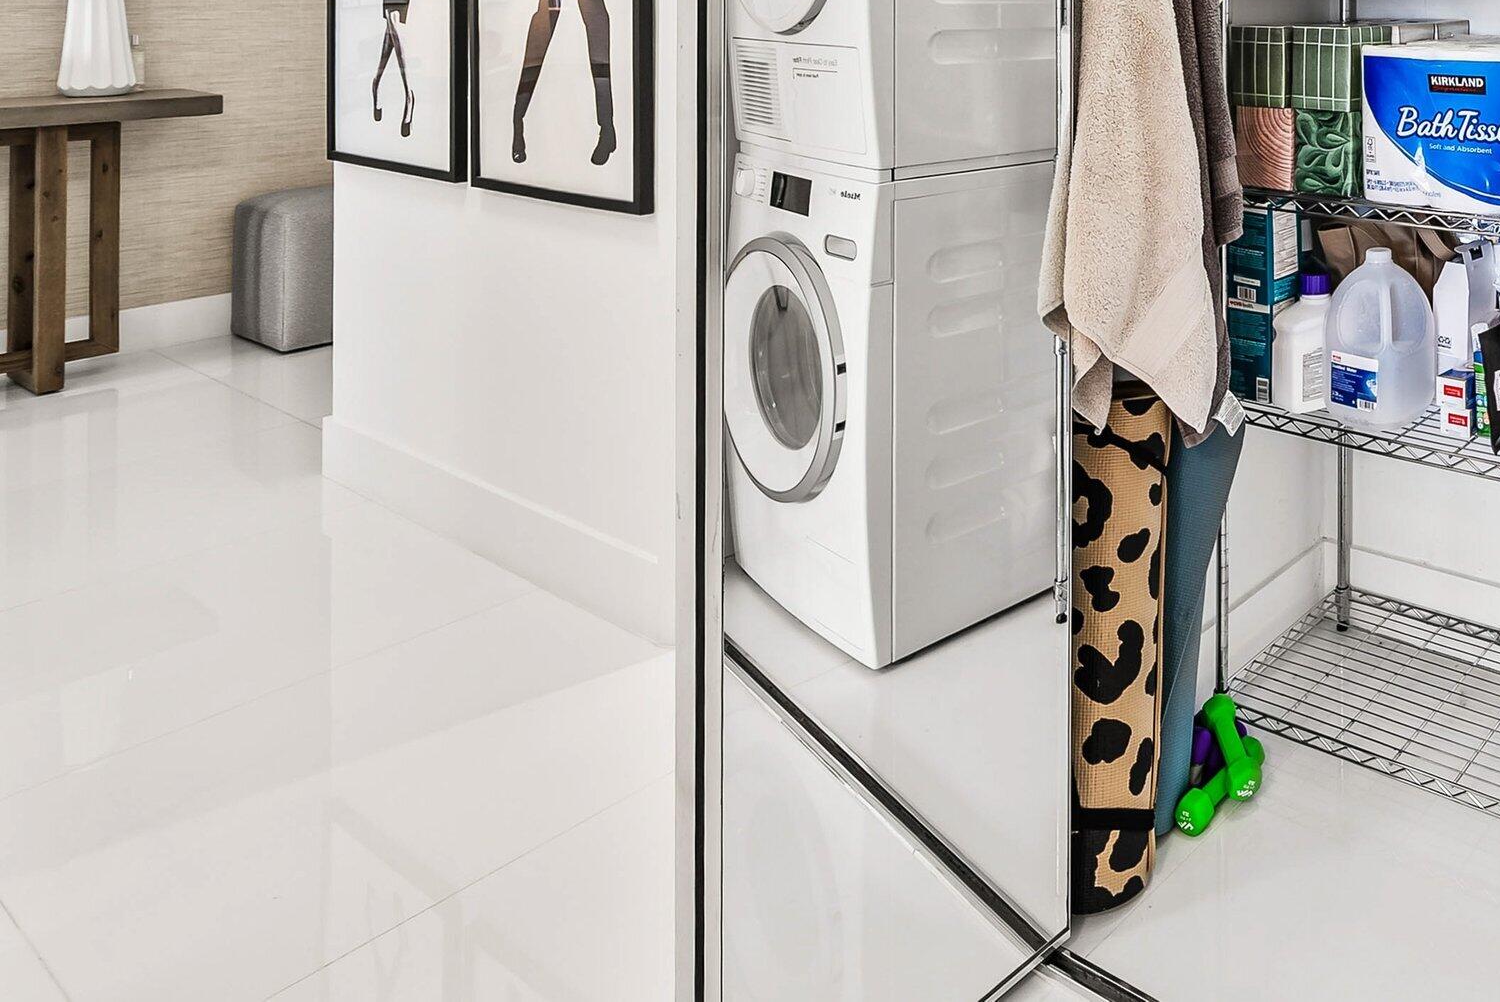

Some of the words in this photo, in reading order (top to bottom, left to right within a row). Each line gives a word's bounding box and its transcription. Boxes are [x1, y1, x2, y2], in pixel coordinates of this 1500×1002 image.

[1431, 76, 1484, 87] KIRKLAND
[1397, 107, 1458, 138] Bath
[1457, 146, 1492, 154] Absorbent
